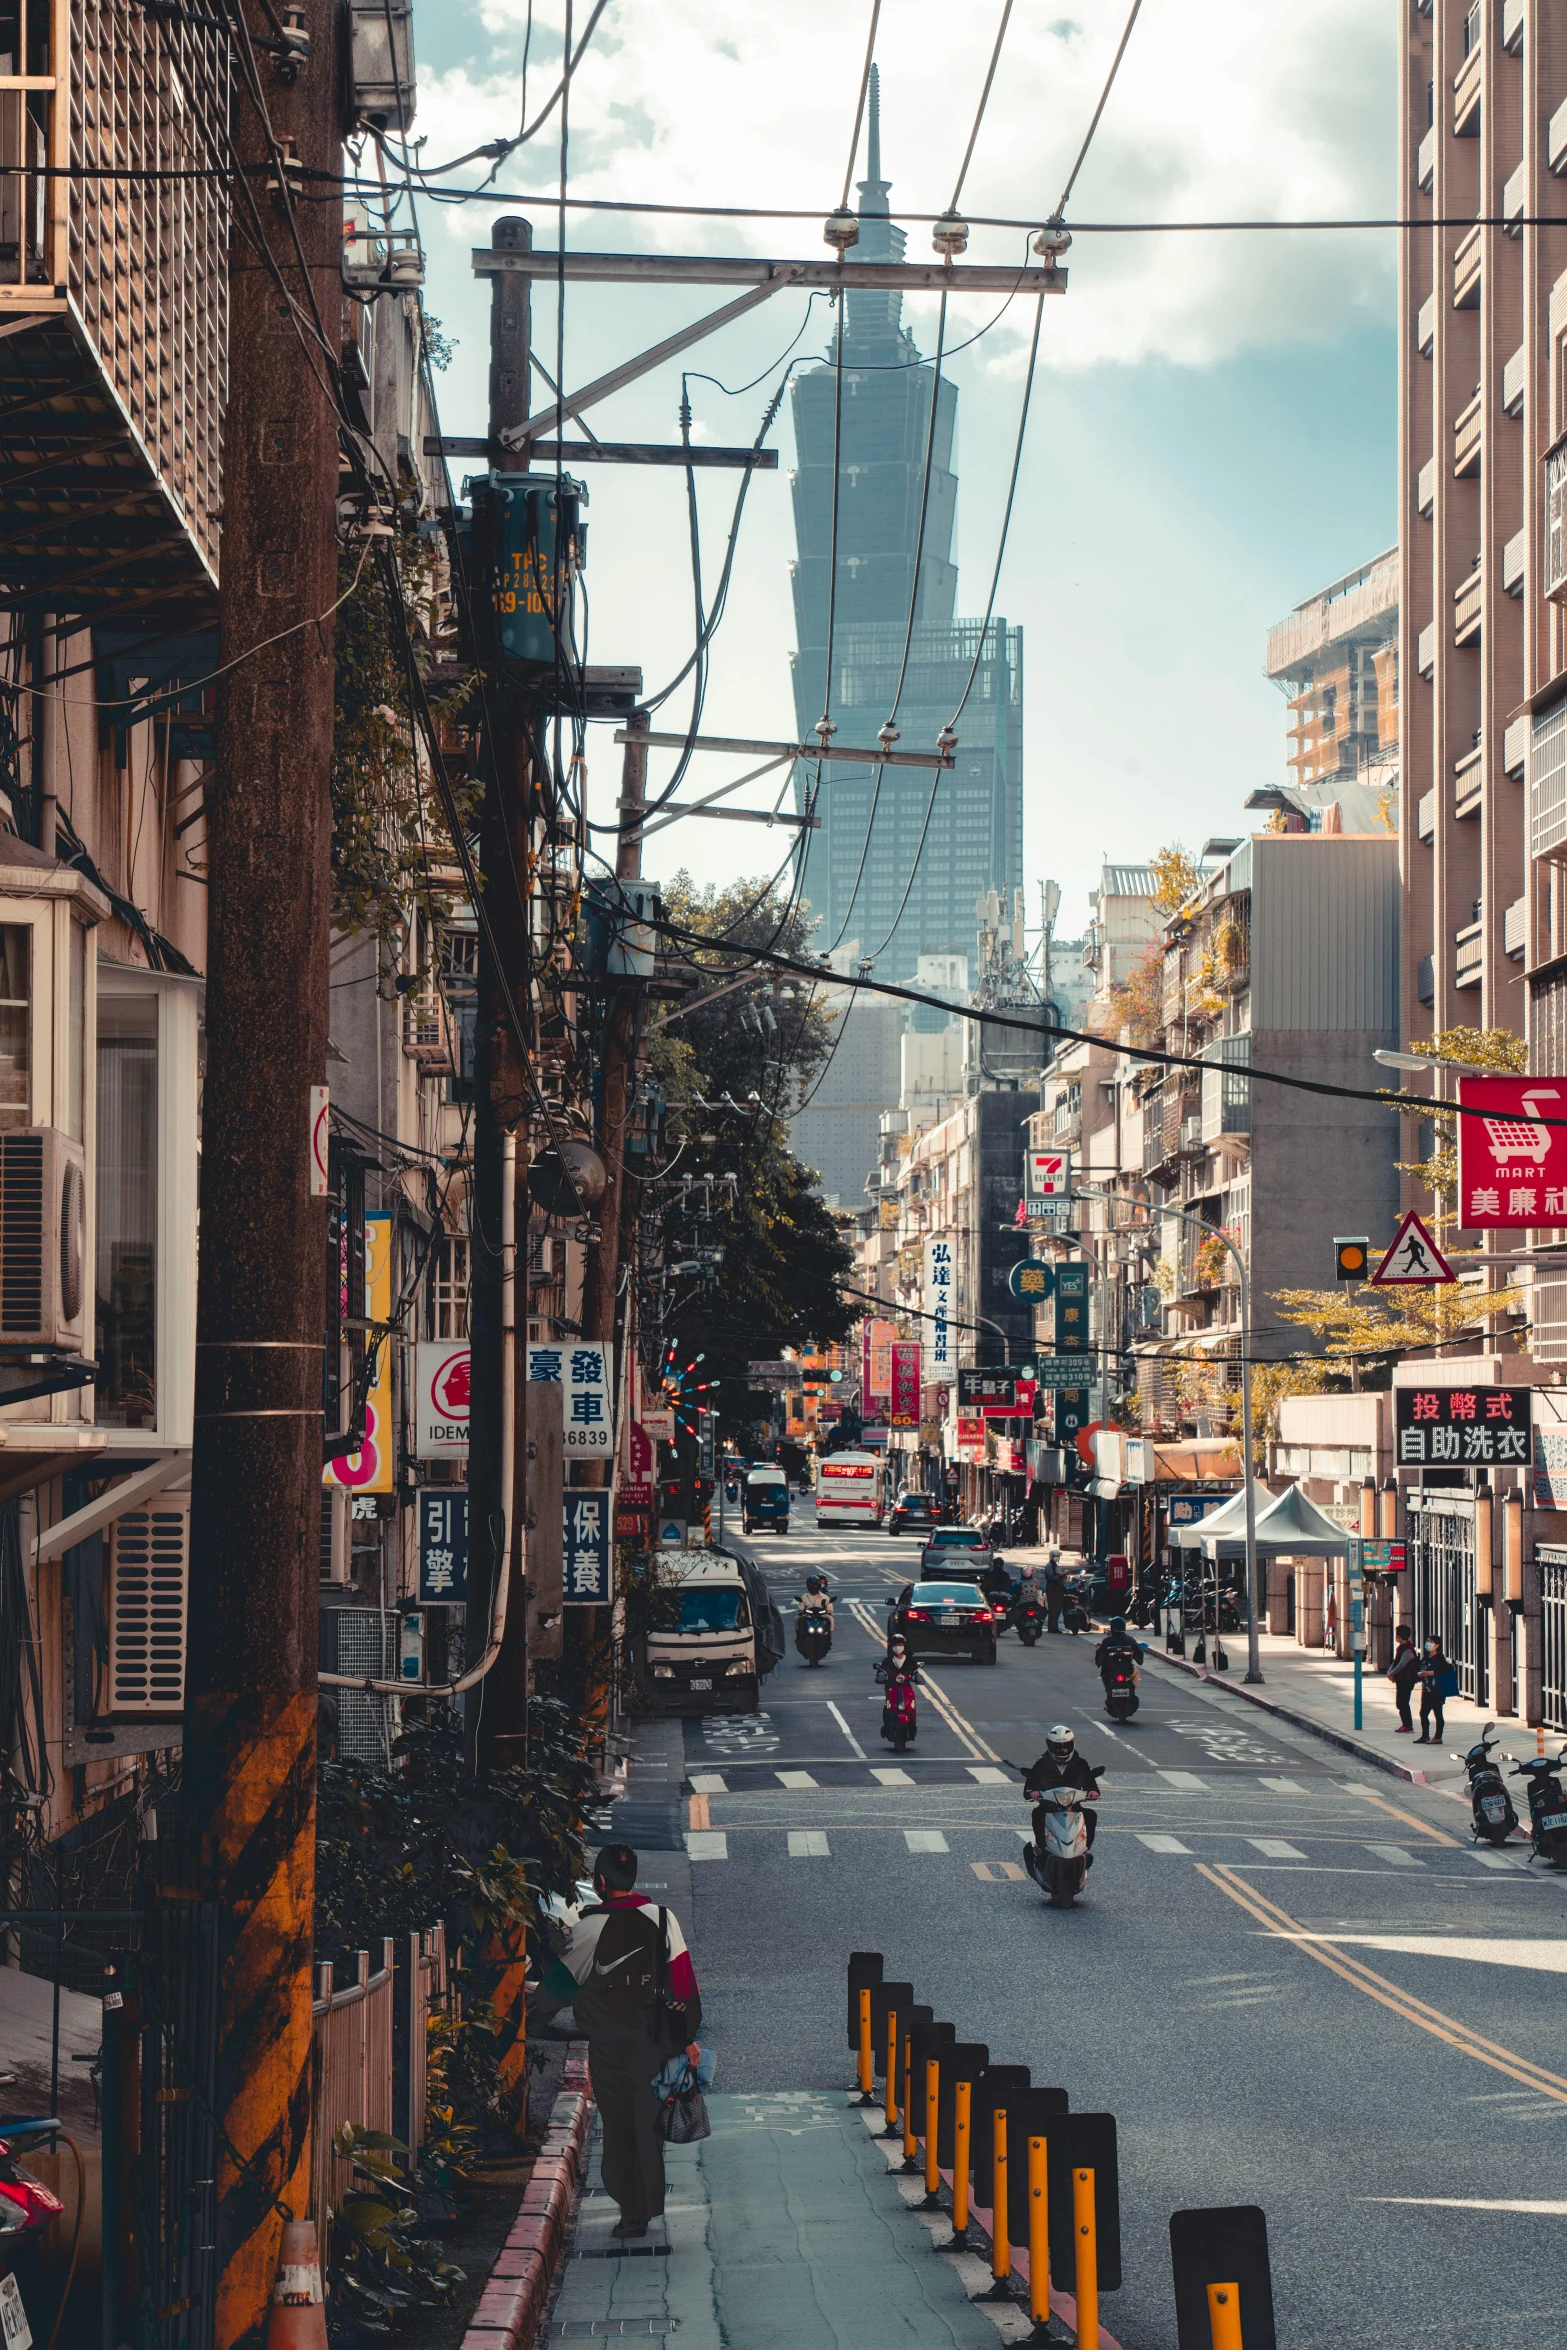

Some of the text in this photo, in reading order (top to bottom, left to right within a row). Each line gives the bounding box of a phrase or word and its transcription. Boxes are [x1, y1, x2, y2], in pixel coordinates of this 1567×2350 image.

[511, 552, 547, 571] TPC
[1495, 1167, 1546, 1178] MART
[1470, 1186, 1567, 1217] 美廉社
[1020, 1268, 1046, 1293] 藥
[896, 1346, 917, 1411] 福德飯包
[1413, 1392, 1514, 1420] 投幣式
[892, 1416, 912, 1425] 60
[1401, 1425, 1527, 1461] 自助洗衣
[617, 1516, 634, 1531] 529
[573, 1500, 601, 1594] 保養
